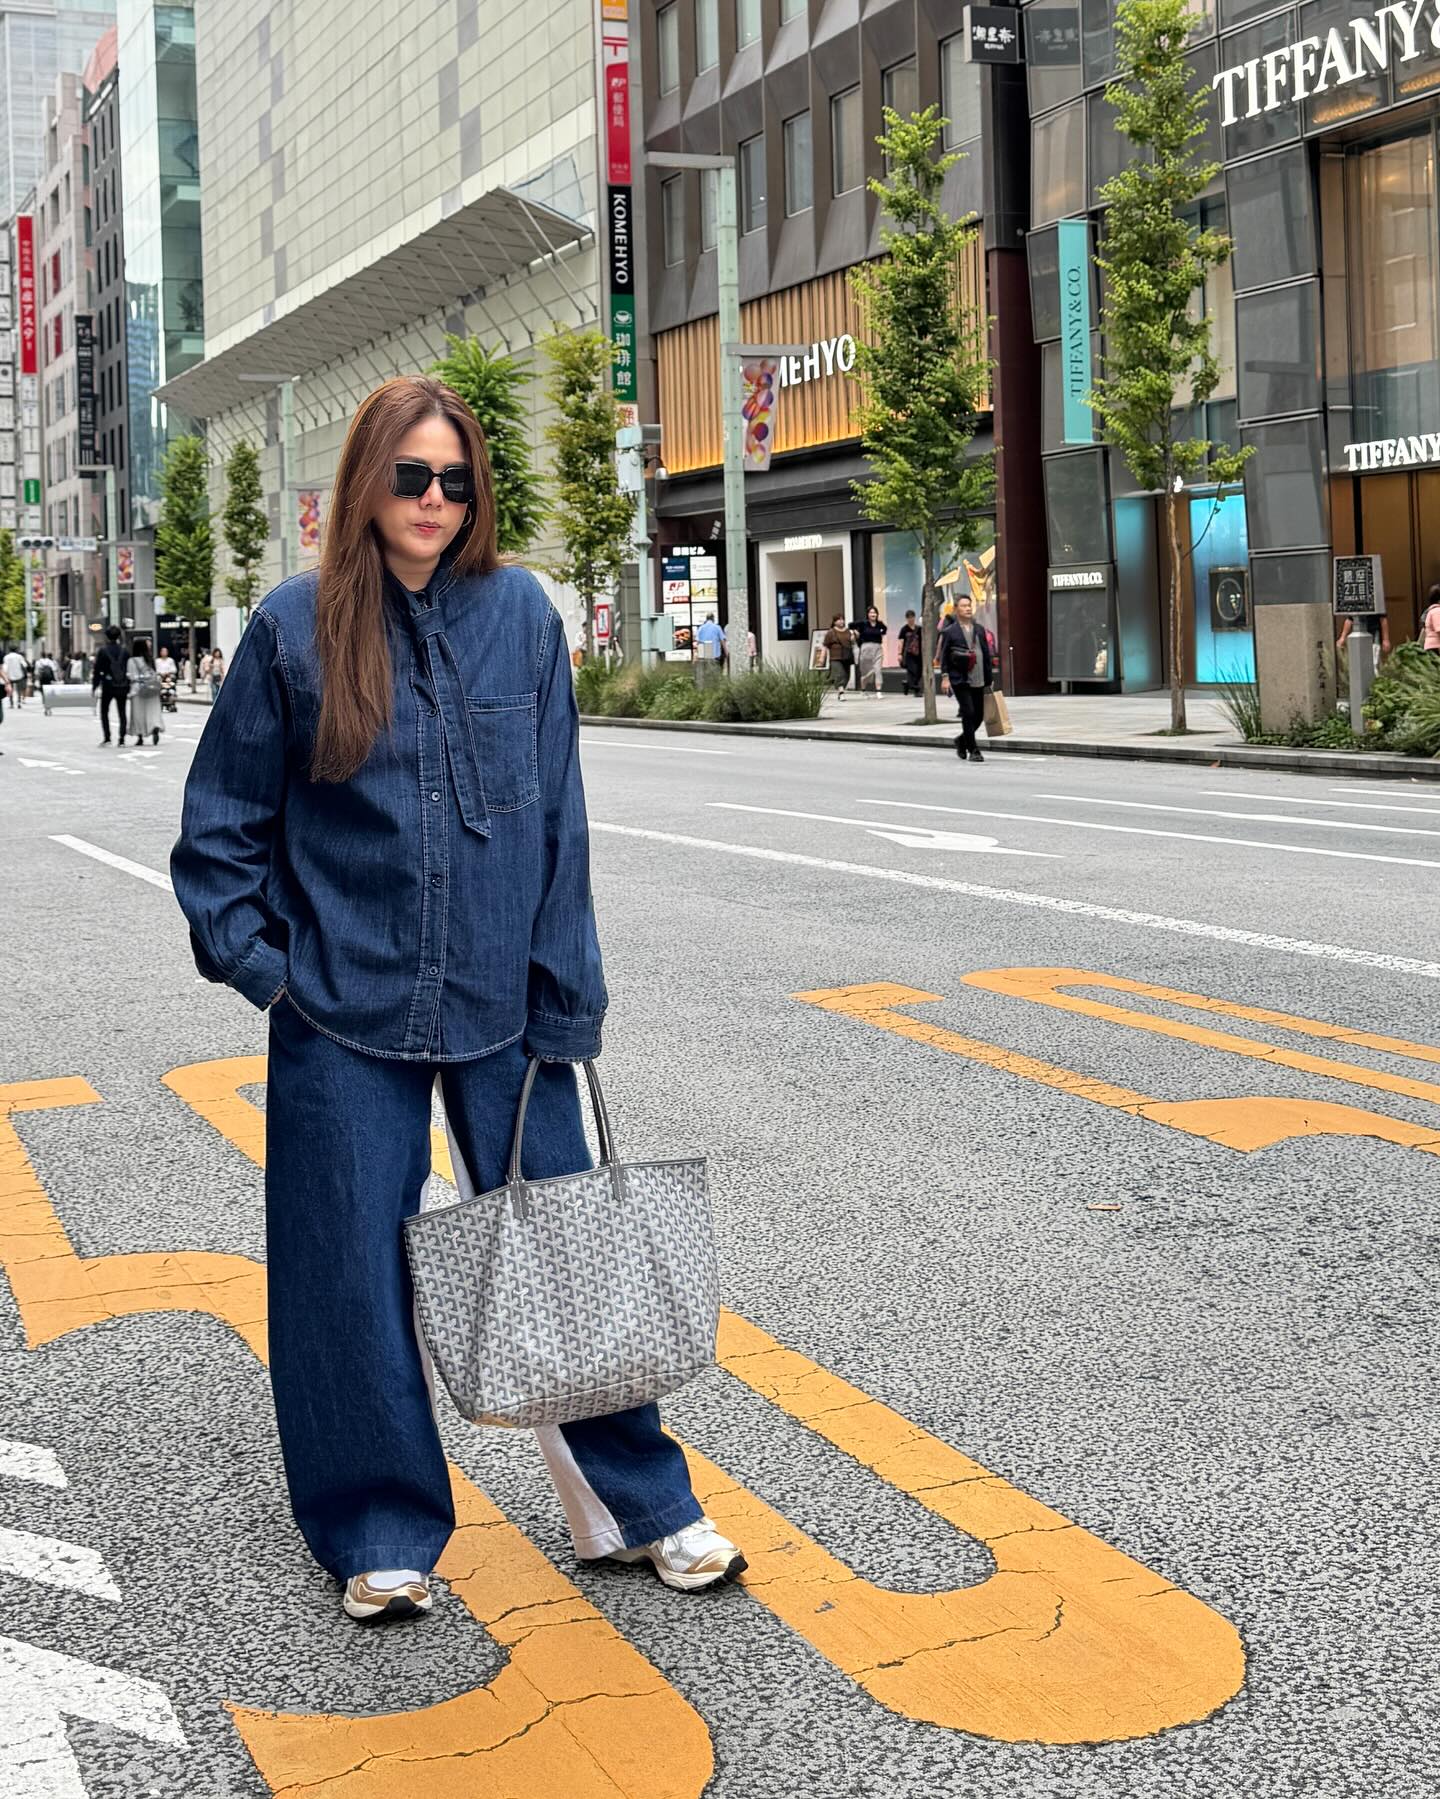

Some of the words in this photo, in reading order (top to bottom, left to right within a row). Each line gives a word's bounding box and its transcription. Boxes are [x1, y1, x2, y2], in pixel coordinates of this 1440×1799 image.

[1212, 0, 1440, 127] TIFFANY
[613, 193, 630, 285] KOMEHYO
[615, 332, 632, 386] 珈琲館
[1343, 569, 1366, 583] 銀座
[1344, 583, 1366, 595] 2丁目
